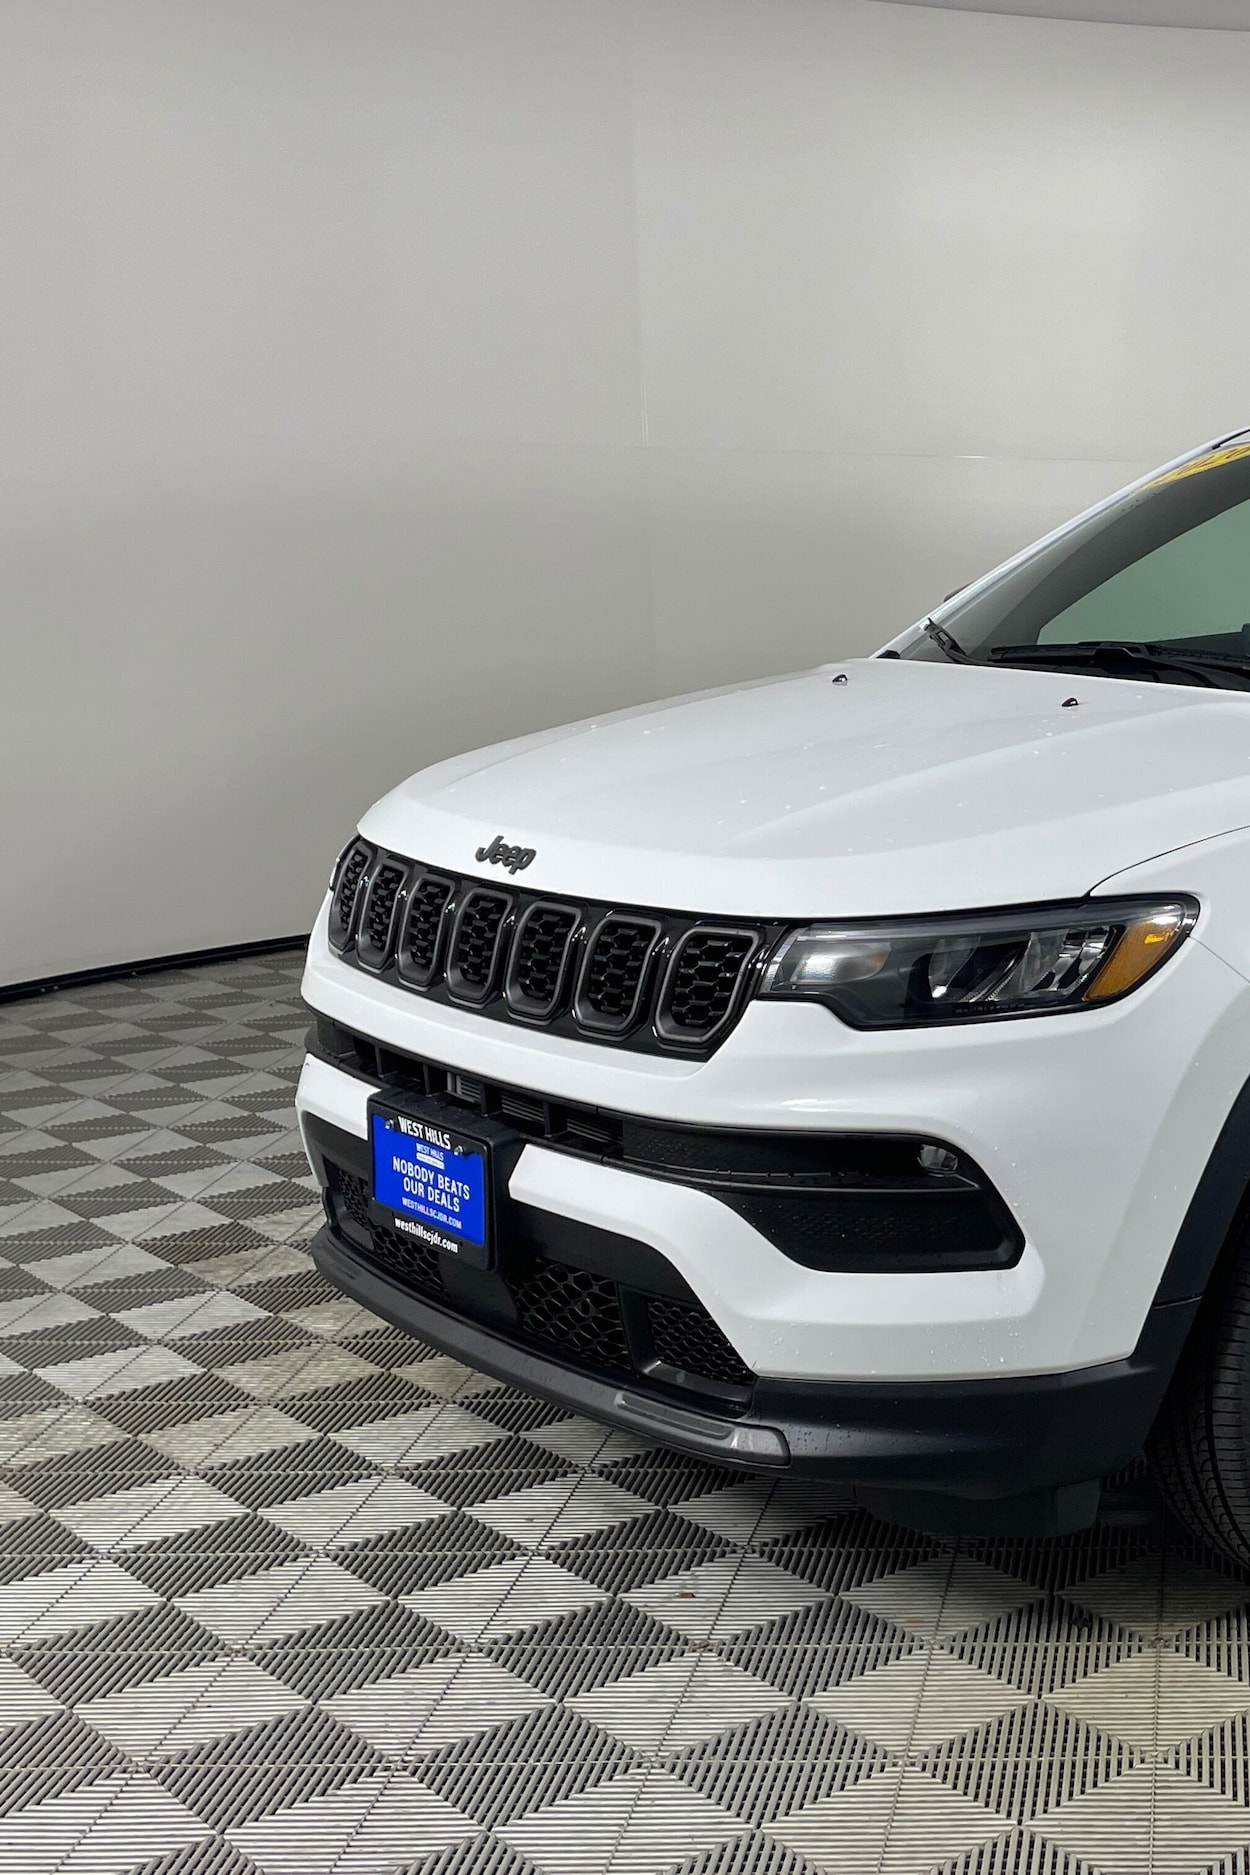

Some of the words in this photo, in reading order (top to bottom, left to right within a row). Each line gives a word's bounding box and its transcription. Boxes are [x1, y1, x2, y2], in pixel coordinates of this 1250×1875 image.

[475, 835, 537, 875] Jeep
[398, 1116, 424, 1139] WEST
[425, 1126, 451, 1150] HILLS
[416, 1143, 430, 1155] WEST
[430, 1148, 444, 1161] HILLS
[392, 1156, 435, 1185] NOBODY
[438, 1174, 470, 1200] BEATS
[403, 1177, 425, 1198] OUR
[428, 1186, 460, 1212] DEALS
[402, 1197, 462, 1229] WESTHILLSCJDR.COM
[395, 1217, 458, 1253] westhillscjdr.com
